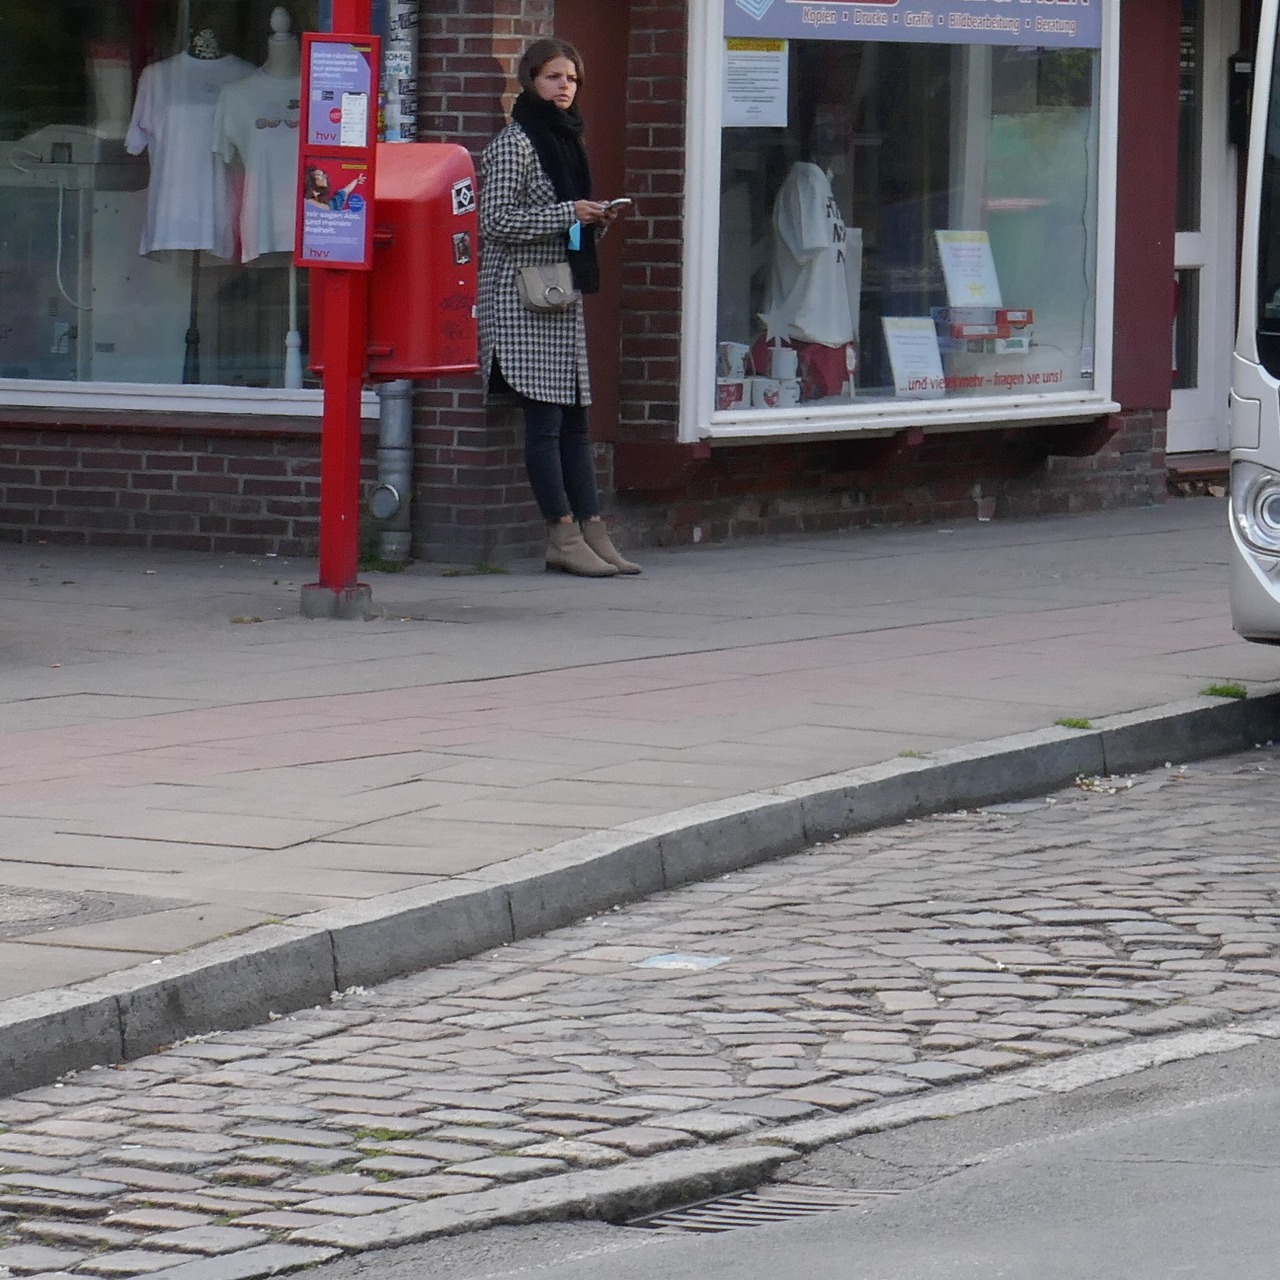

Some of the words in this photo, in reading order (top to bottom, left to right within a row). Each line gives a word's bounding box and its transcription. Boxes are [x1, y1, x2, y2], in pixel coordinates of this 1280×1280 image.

[803, 7, 837, 27] Kopien
[853, 8, 888, 27] Drucke
[904, 10, 933, 28] Grafik
[949, 12, 1021, 35] Bildbearbeitung
[1035, 15, 1077, 37] Beratung
[316, 131, 337, 141] hvv
[1042, 370, 1063, 384] uns!
